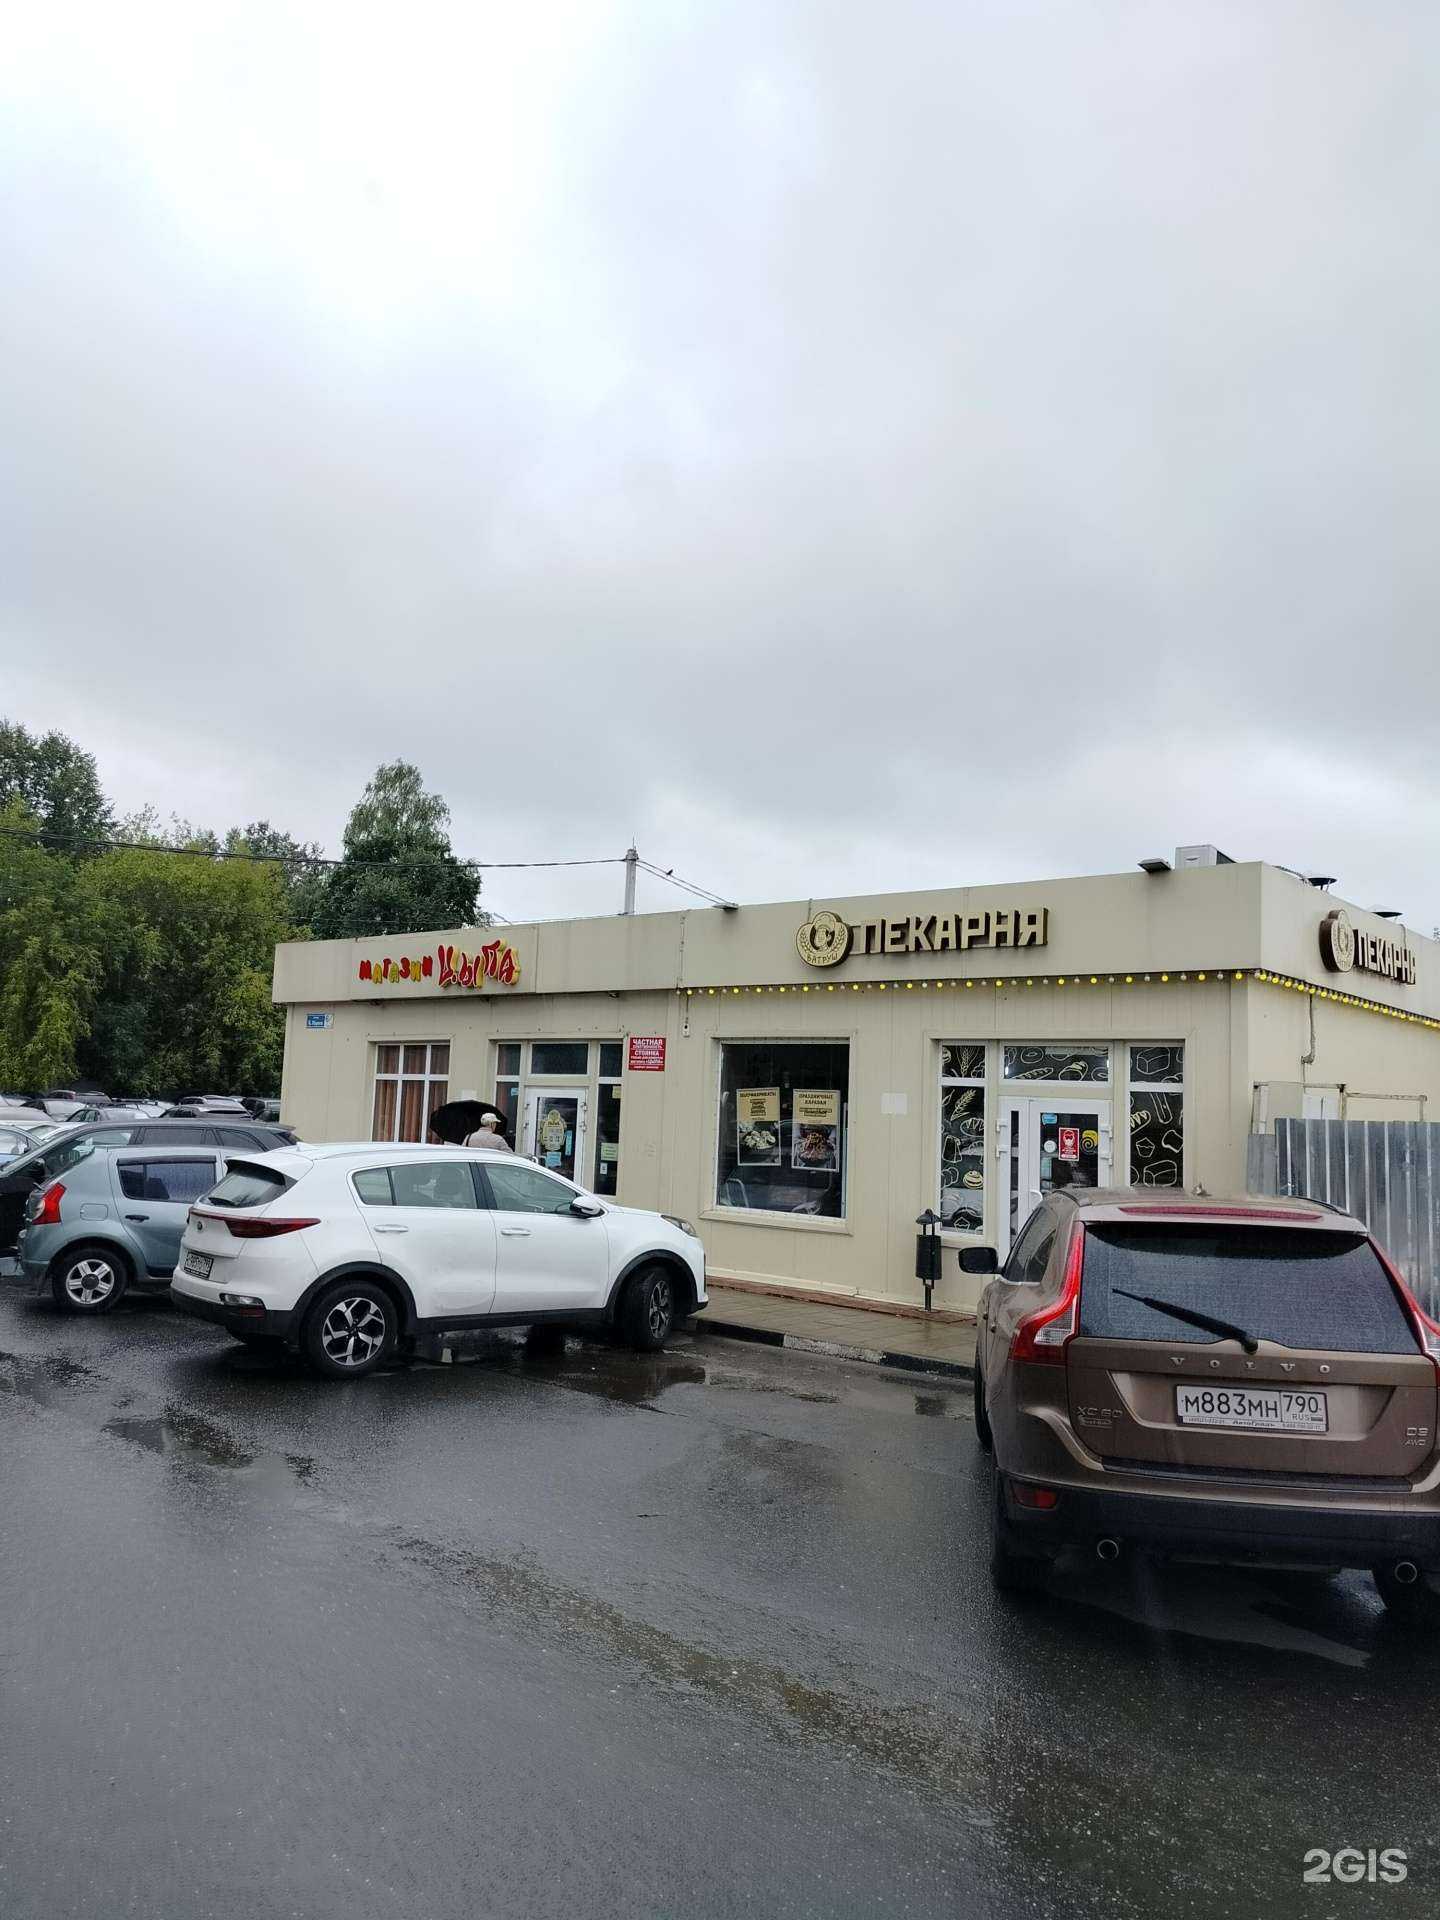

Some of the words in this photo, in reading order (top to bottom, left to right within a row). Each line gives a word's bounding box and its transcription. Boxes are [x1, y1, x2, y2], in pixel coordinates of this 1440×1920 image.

[859, 908, 1048, 954] ПЕКАРНЯ
[359, 955, 433, 984] МАГАЗИН
[437, 939, 521, 989] ЦЫПА
[1355, 929, 1416, 985] ПЕКАРНЯ
[632, 1038, 663, 1046] ЧАСТНАЯ
[1170, 1357, 1330, 1373] VOLVO
[1283, 1395, 1319, 1413] 790
[1292, 1413, 1310, 1421] RUS
